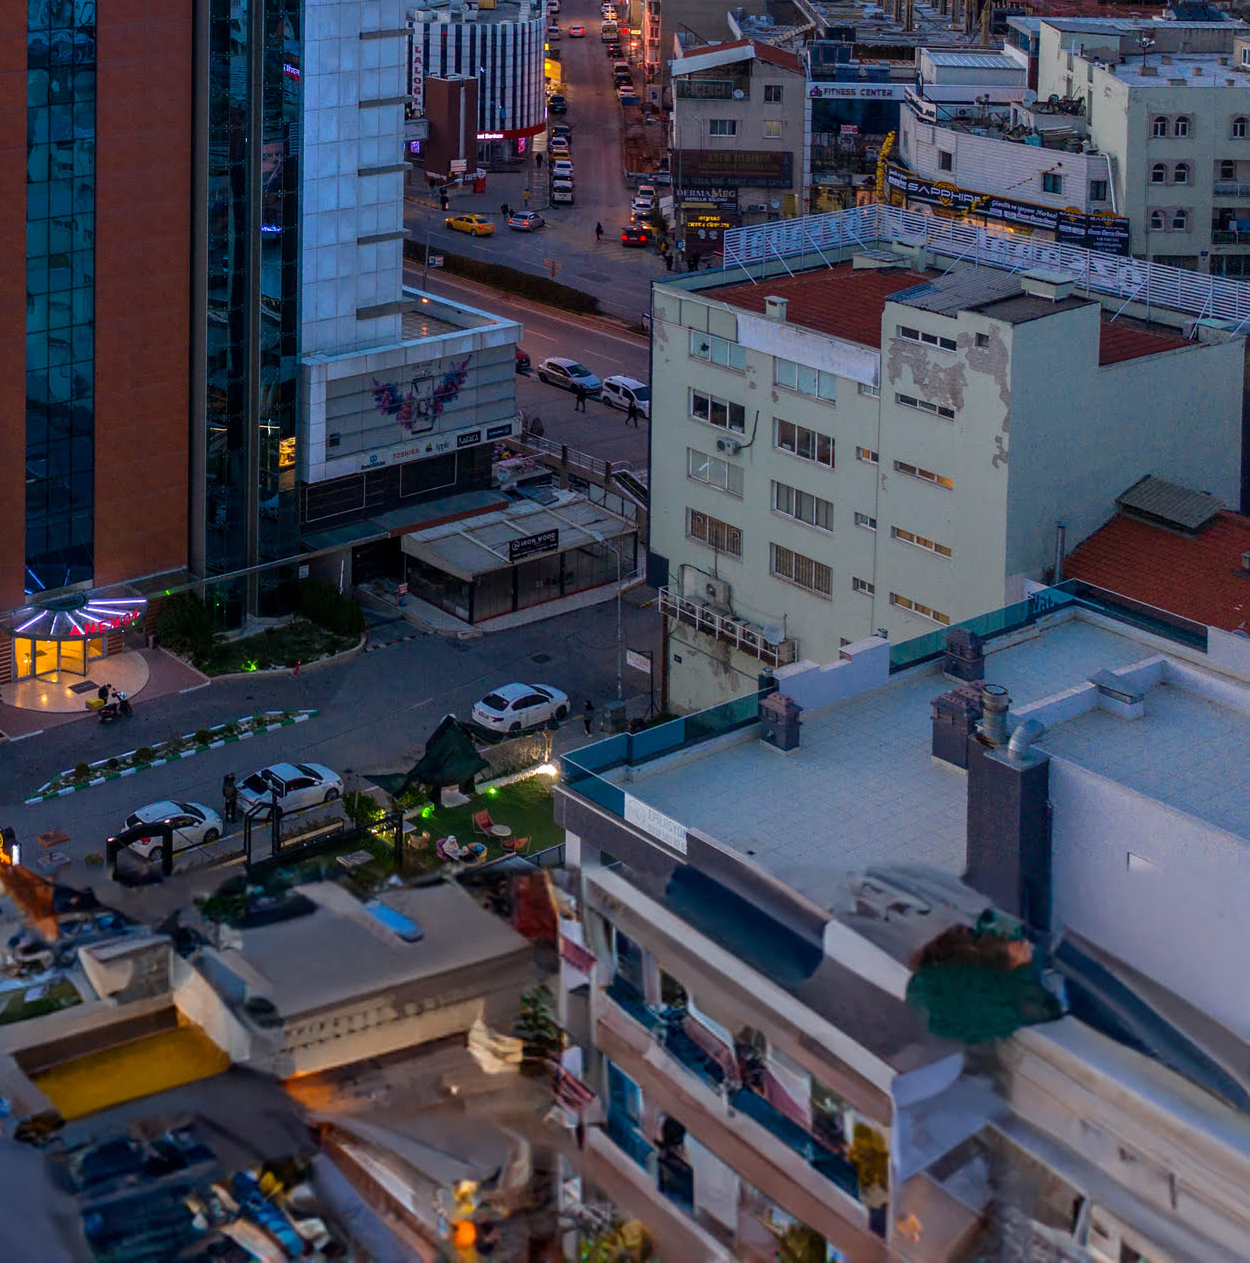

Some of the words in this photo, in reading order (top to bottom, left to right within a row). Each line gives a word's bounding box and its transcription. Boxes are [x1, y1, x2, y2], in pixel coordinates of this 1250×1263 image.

[823, 87, 856, 96] FITNESS
[860, 88, 893, 97] CENTER
[392, 447, 420, 459] TOSHIBA
[434, 440, 449, 453] Apple
[458, 432, 479, 446] KARACA
[520, 537, 536, 546] IRON
[537, 532, 556, 543] WOOD
[70, 607, 139, 636] ANEMON
